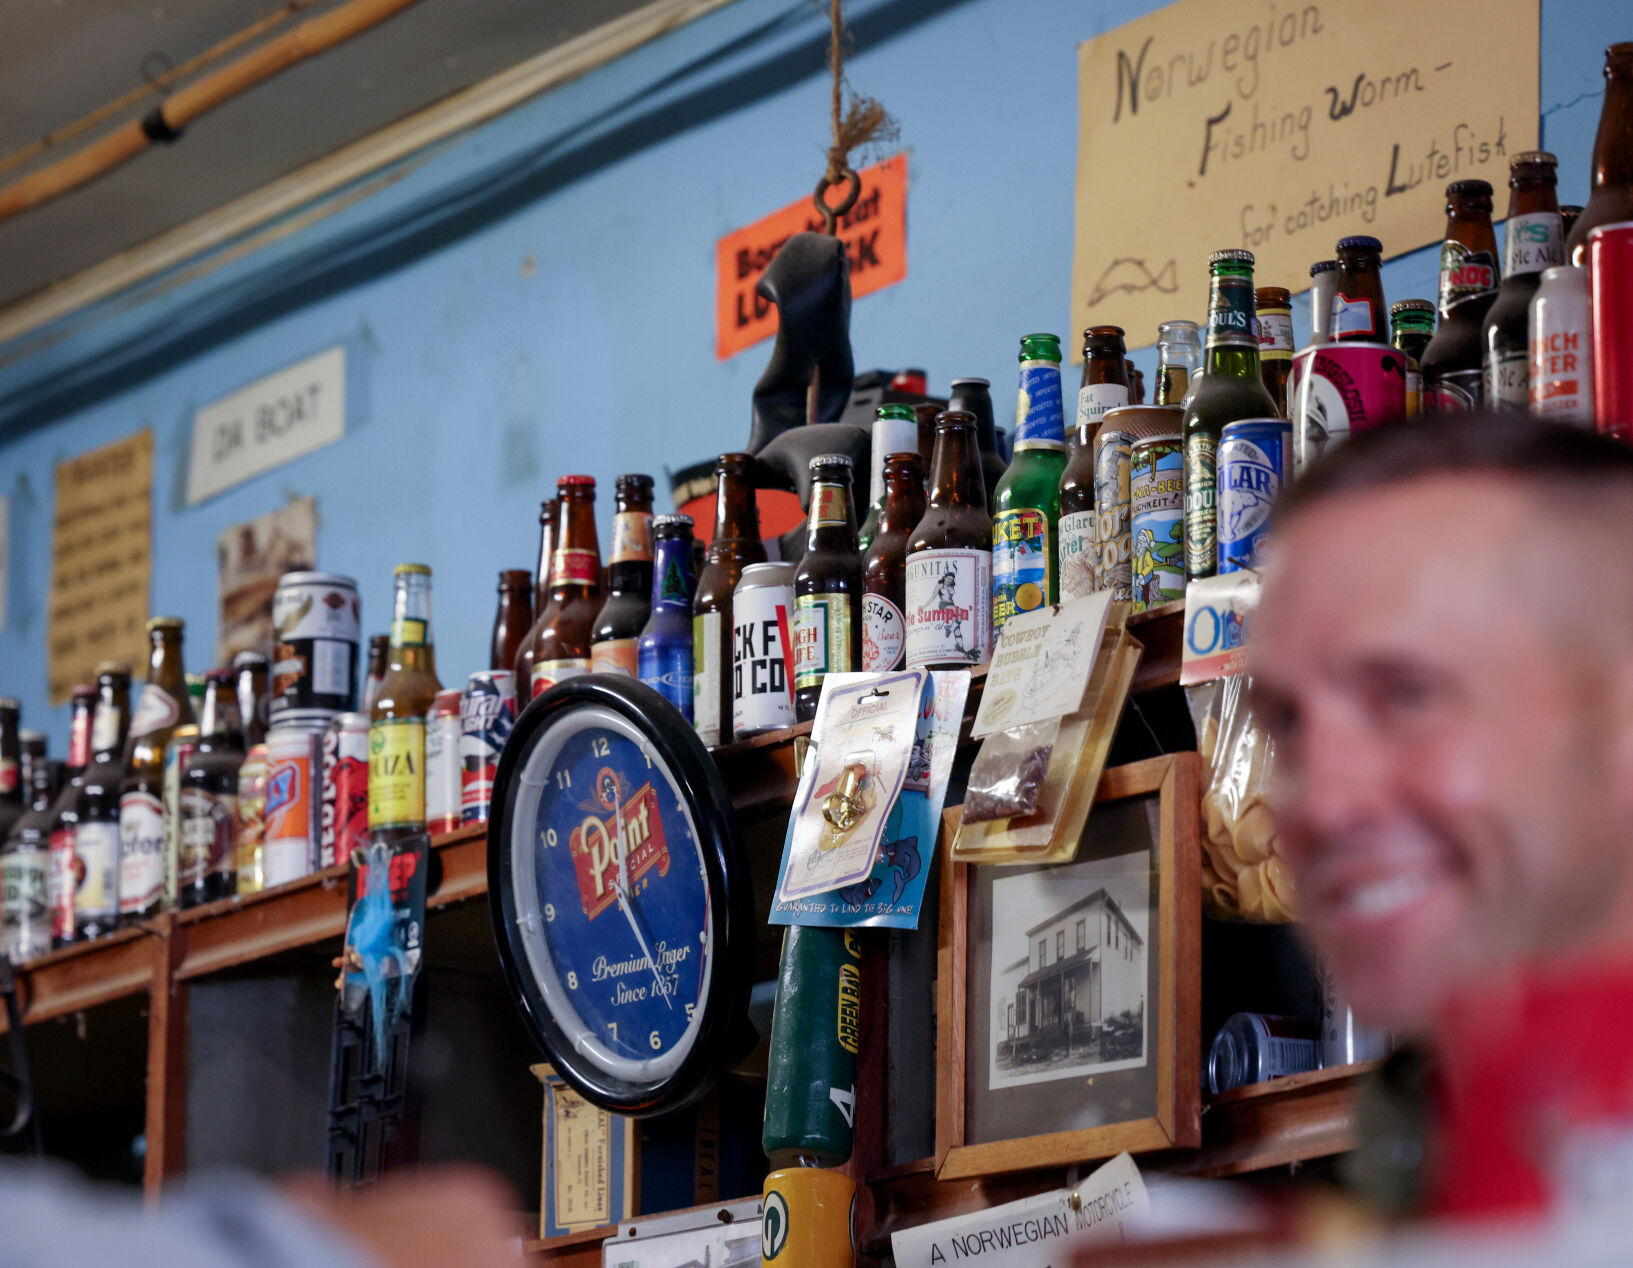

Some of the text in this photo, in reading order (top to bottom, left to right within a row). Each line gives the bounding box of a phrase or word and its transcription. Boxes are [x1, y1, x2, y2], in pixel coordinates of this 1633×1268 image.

[1113, 3, 1325, 122] Norwegian
[1199, 100, 1312, 177] Fishing
[1325, 65, 1425, 122] Worm
[1240, 116, 1508, 251] for catching Lutefisk
[254, 382, 323, 445] BOAT
[850, 702, 889, 719] OFFICIAL
[591, 737, 610, 758] 12
[556, 769, 573, 790] 11
[540, 828, 558, 849] 10
[581, 797, 651, 901] Point
[608, 843, 655, 891] SPCIAL
[544, 902, 556, 923] 9
[591, 940, 691, 983] Premium Lager
[566, 970, 579, 991] 8
[611, 981, 647, 1007] Since
[607, 1021, 619, 1043] 7
[839, 997, 860, 1047] GREEN
[649, 1030, 663, 1051] 6
[930, 1181, 1136, 1266] A NORWEGIAN MOTORCYCLE
